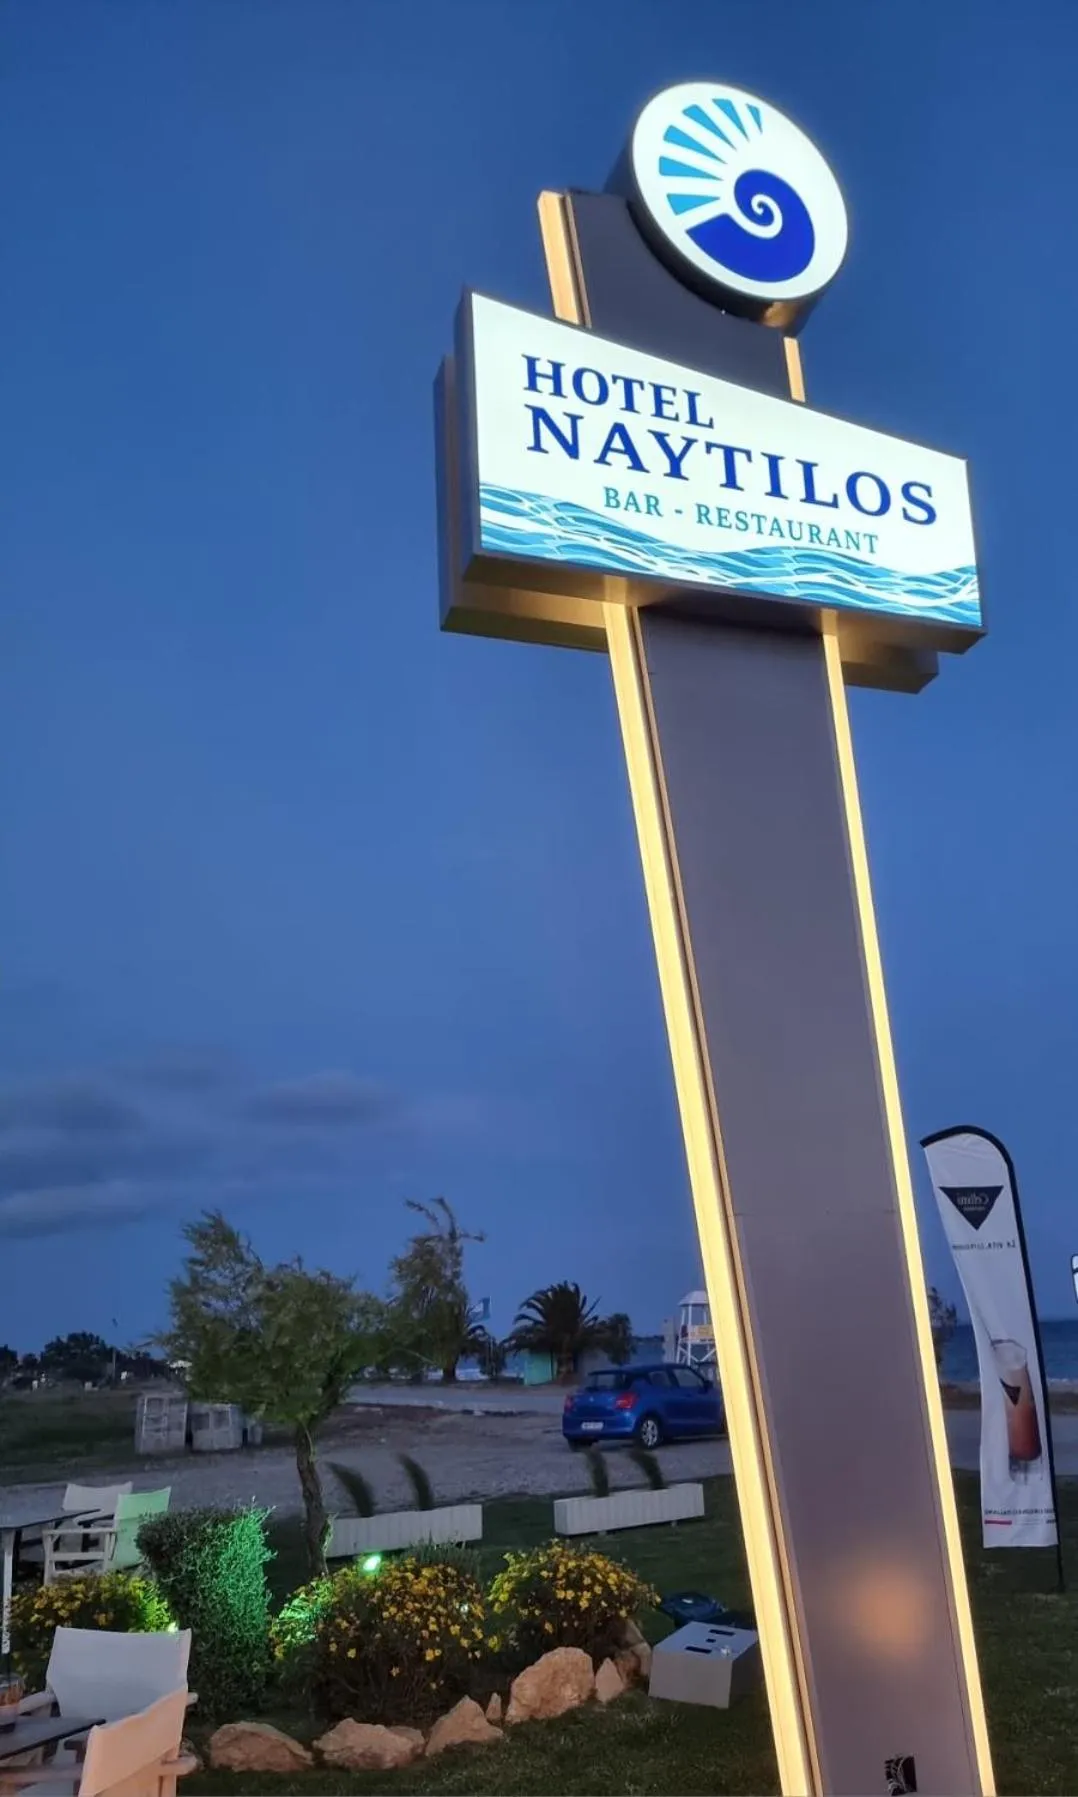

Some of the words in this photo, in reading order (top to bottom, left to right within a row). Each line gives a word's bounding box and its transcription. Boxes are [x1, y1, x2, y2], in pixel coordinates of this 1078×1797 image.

[521, 354, 714, 430] HOTEL
[524, 403, 937, 526] NAYTILOS
[604, 486, 664, 517] BAR
[696, 503, 879, 555] RESTAURANT
